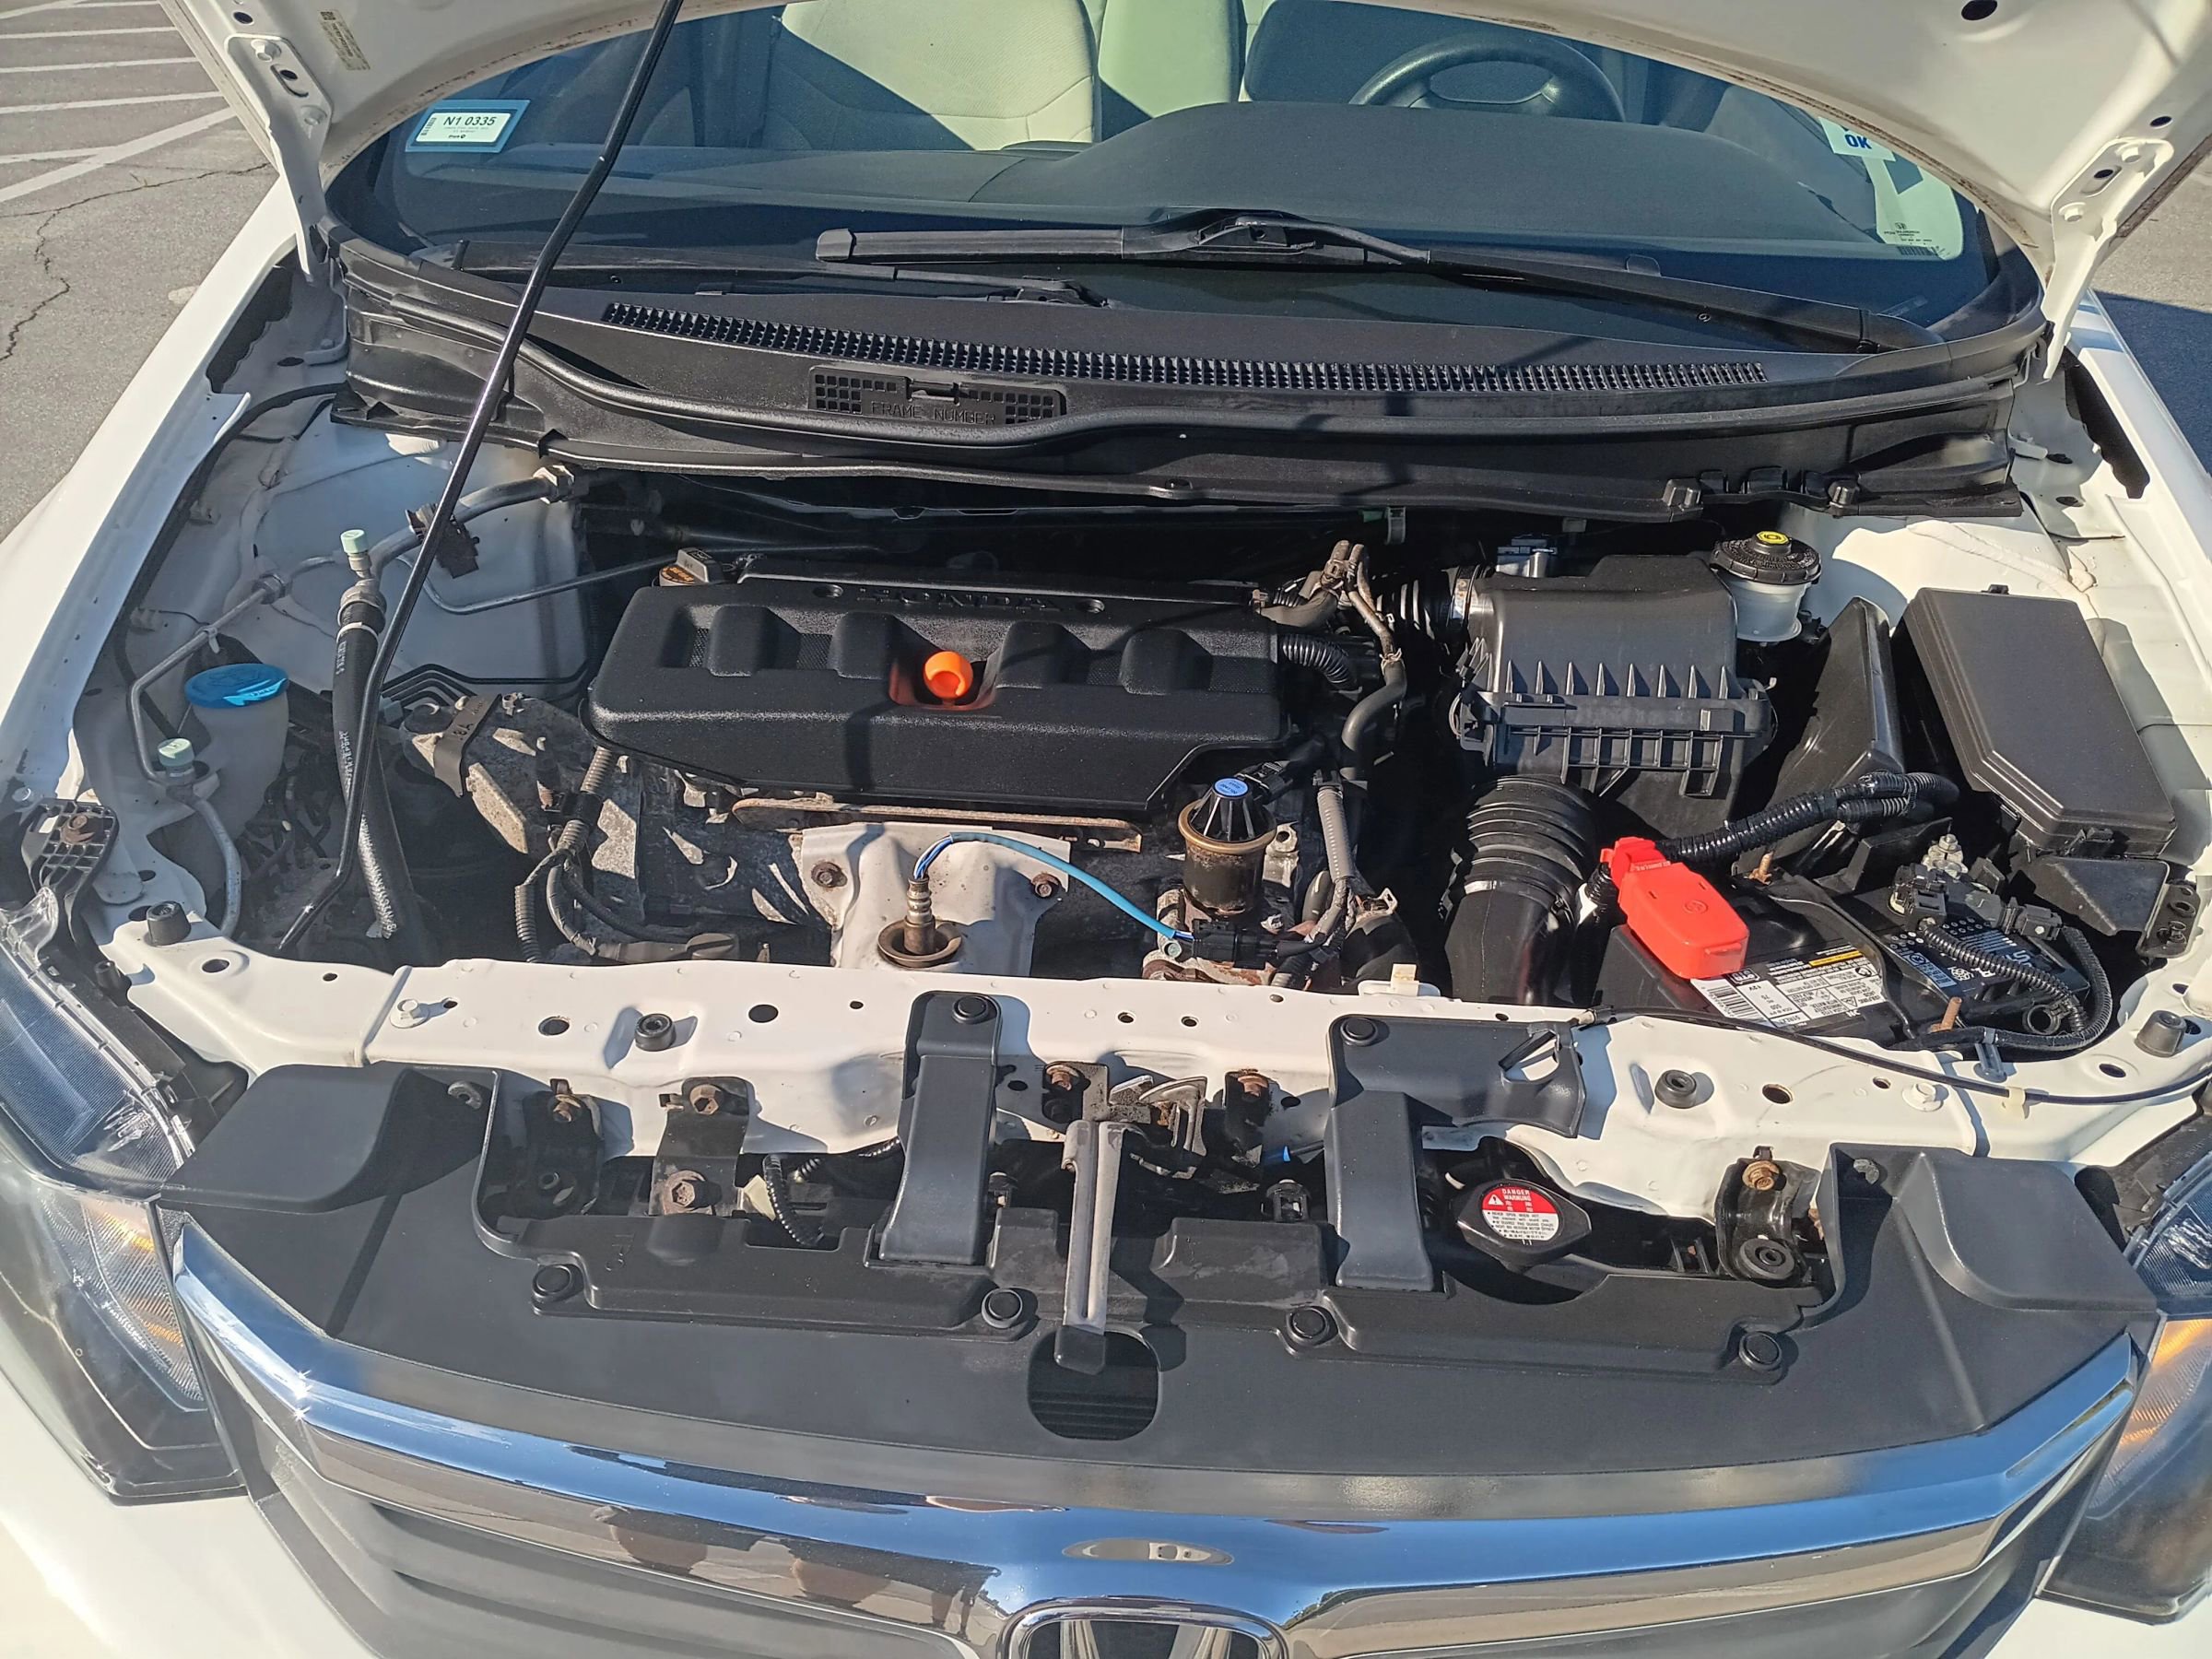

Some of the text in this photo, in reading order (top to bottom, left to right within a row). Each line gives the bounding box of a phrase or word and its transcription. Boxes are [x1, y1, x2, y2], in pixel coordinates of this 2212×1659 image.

[442, 116, 498, 126] N1 0335
[1844, 134, 1872, 149] OK
[871, 401, 996, 426] FRAME NUMBER
